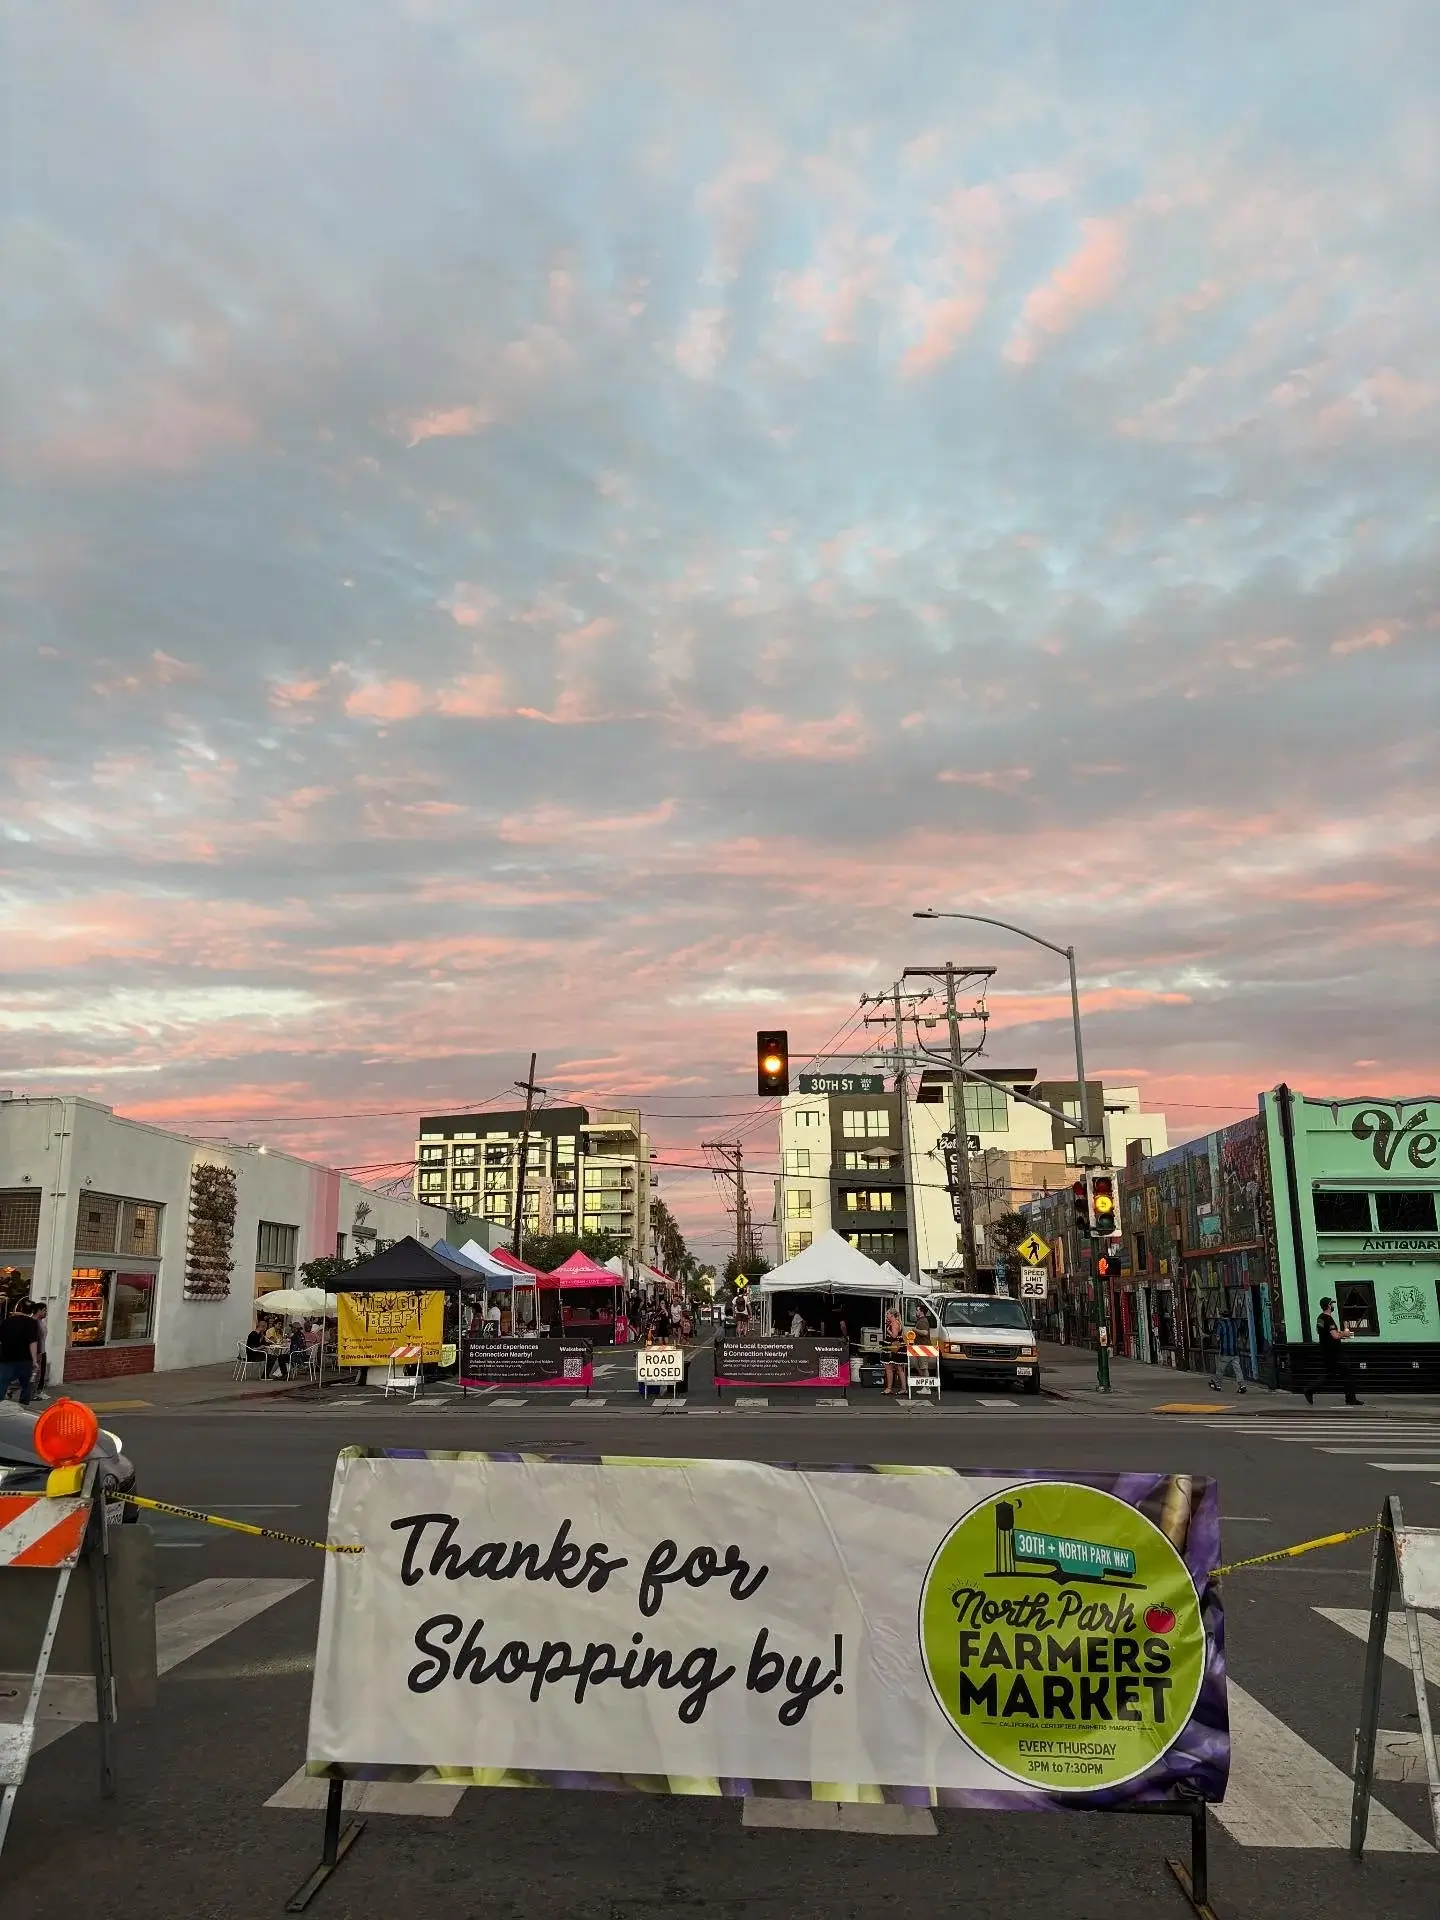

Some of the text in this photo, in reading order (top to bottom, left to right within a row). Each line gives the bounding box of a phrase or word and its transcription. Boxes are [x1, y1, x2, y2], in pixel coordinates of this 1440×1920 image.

[811, 1078, 839, 1091] 30TH
[841, 1078, 854, 1091] ST
[1352, 1109, 1440, 1170] Ve
[949, 1153, 961, 1217] CENER
[1024, 1283, 1044, 1295] 25
[356, 1294, 384, 1312] WE
[368, 1310, 414, 1328] BEEF
[645, 1355, 675, 1365] ROAD
[639, 1367, 681, 1377] CLOSED
[1018, 1534, 1045, 1555] 30TH
[1058, 1542, 1089, 1562] NORTH
[1090, 1549, 1112, 1567] PARK
[1113, 1550, 1129, 1568] WAY
[390, 1512, 770, 1618] Thanks for
[951, 1587, 1137, 1635] North Park
[959, 1630, 1172, 1675] FARMERS
[407, 1614, 845, 1727] Shopping by!
[959, 1672, 1173, 1724] MARKET
[999, 1721, 1039, 1729] CALIFORNIA
[1018, 1739, 1117, 1756] EVERY THURSDAY
[1028, 1760, 1104, 1775] 3PM to 7:30PM
